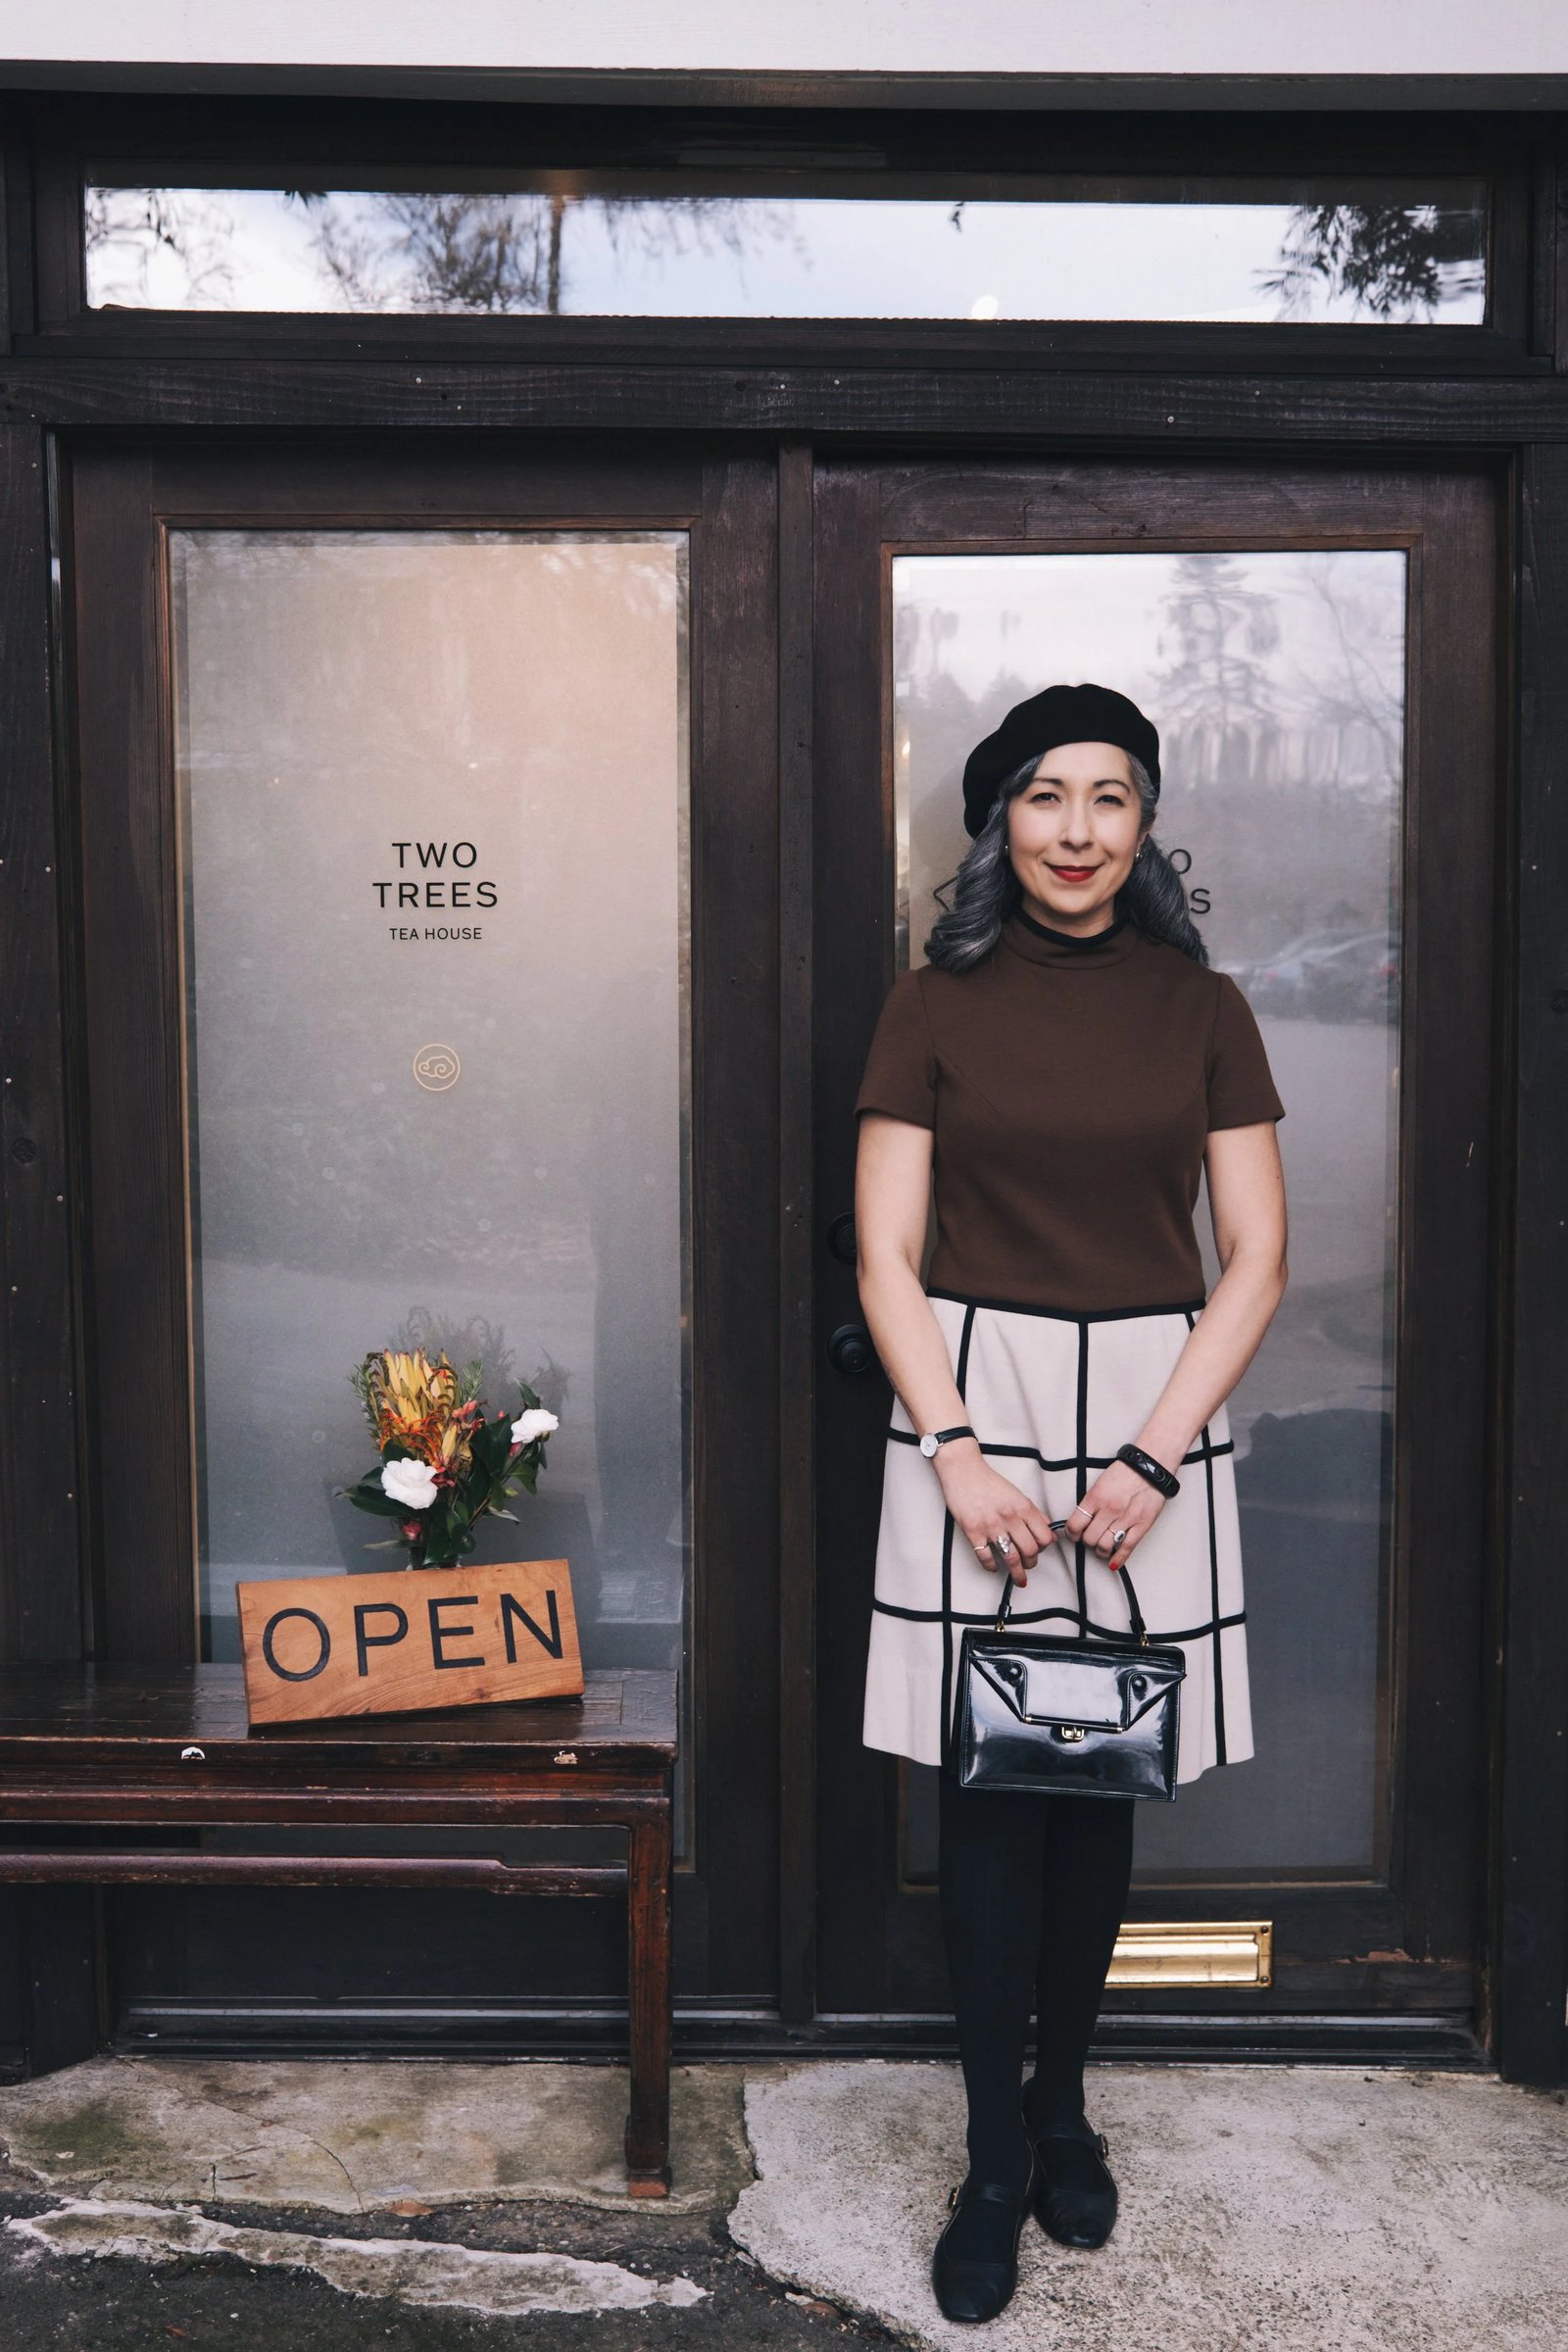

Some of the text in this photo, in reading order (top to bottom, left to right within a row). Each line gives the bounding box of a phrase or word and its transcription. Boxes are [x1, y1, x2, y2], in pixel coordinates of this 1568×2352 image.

[392, 842, 477, 868] TWO
[372, 881, 498, 908] TREES
[389, 927, 482, 941] TEA HOUSE
[263, 1590, 564, 1682] OPEN
